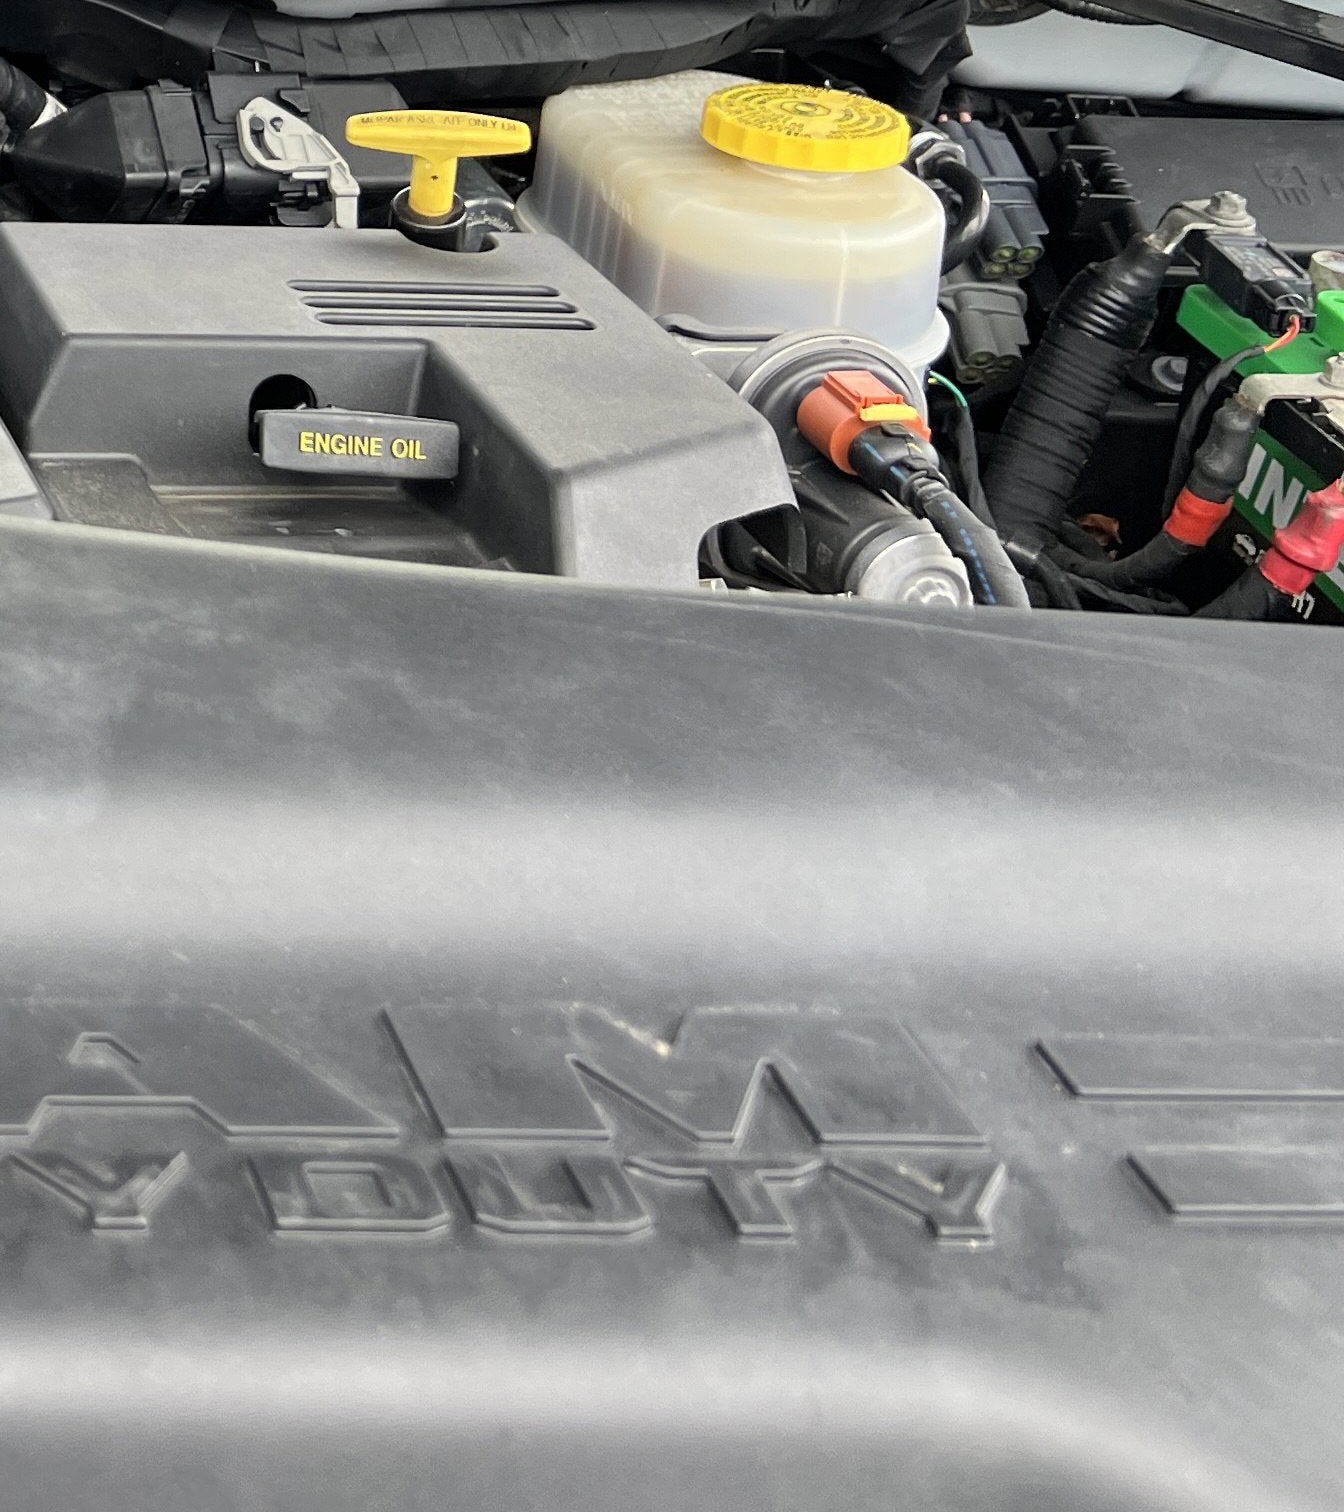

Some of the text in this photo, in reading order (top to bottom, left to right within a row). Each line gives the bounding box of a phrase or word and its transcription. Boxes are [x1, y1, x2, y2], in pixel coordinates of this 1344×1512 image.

[468, 116, 498, 130] ONLY
[299, 431, 428, 461] ENGINE OIL
[245, 1152, 1009, 1248] DUTY
